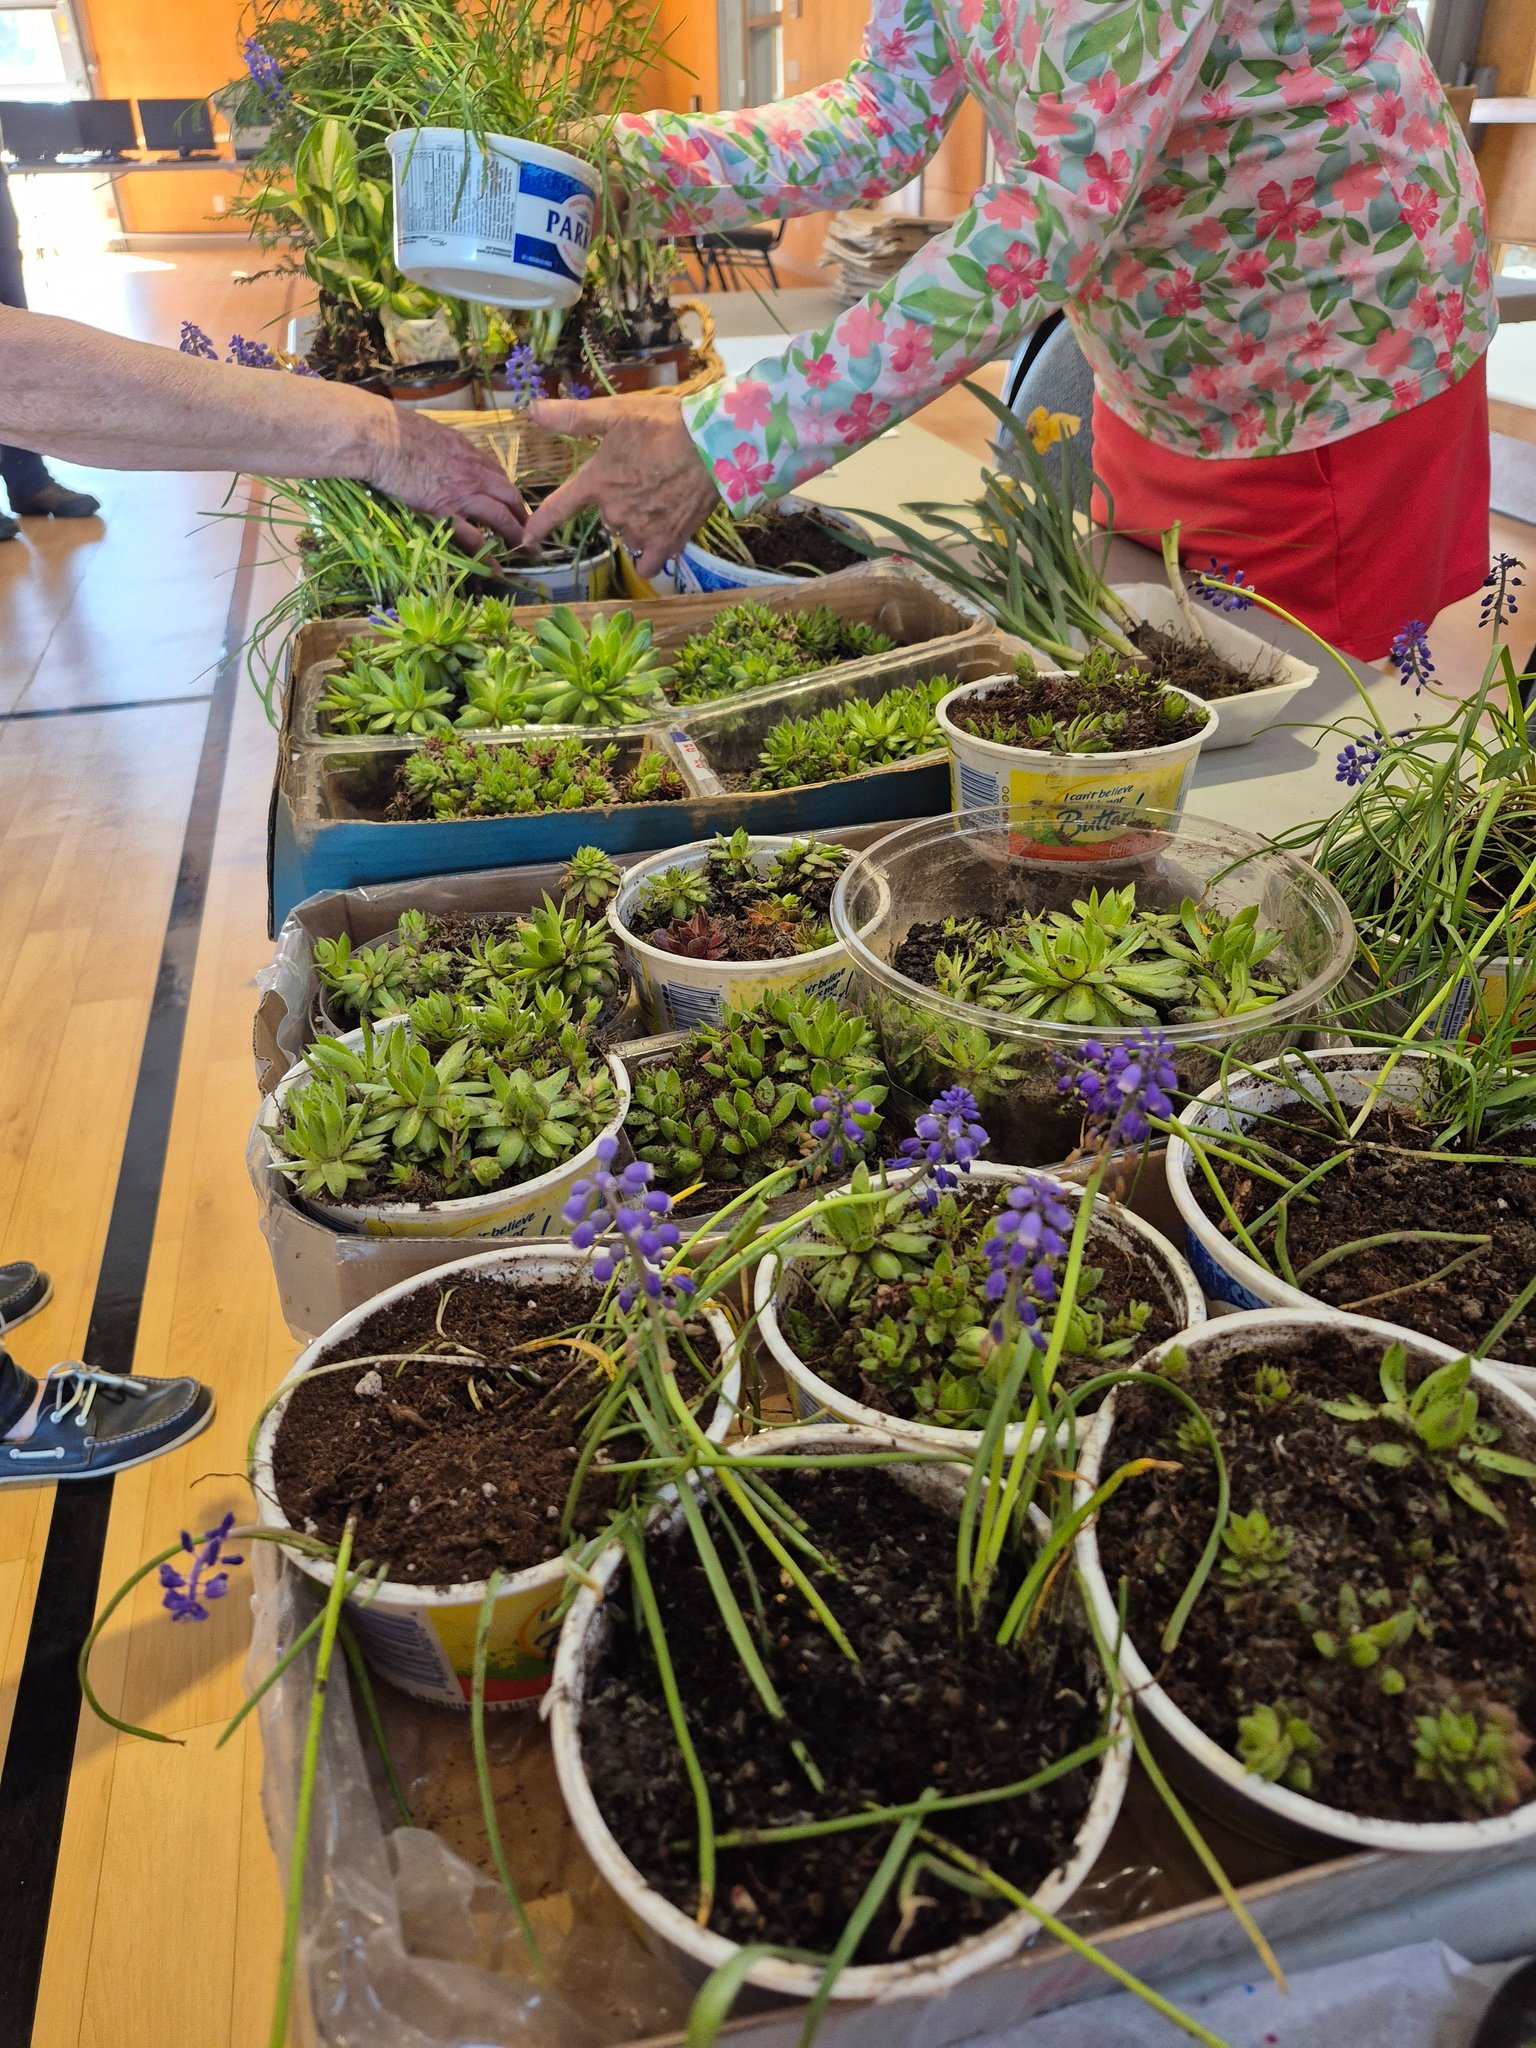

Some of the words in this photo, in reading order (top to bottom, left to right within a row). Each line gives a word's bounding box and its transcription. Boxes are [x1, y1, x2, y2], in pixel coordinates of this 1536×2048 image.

[1070, 791, 1097, 801] can't
[1098, 785, 1134, 799] believe
[817, 967, 846, 989] believe
[490, 1212, 536, 1237] believe
